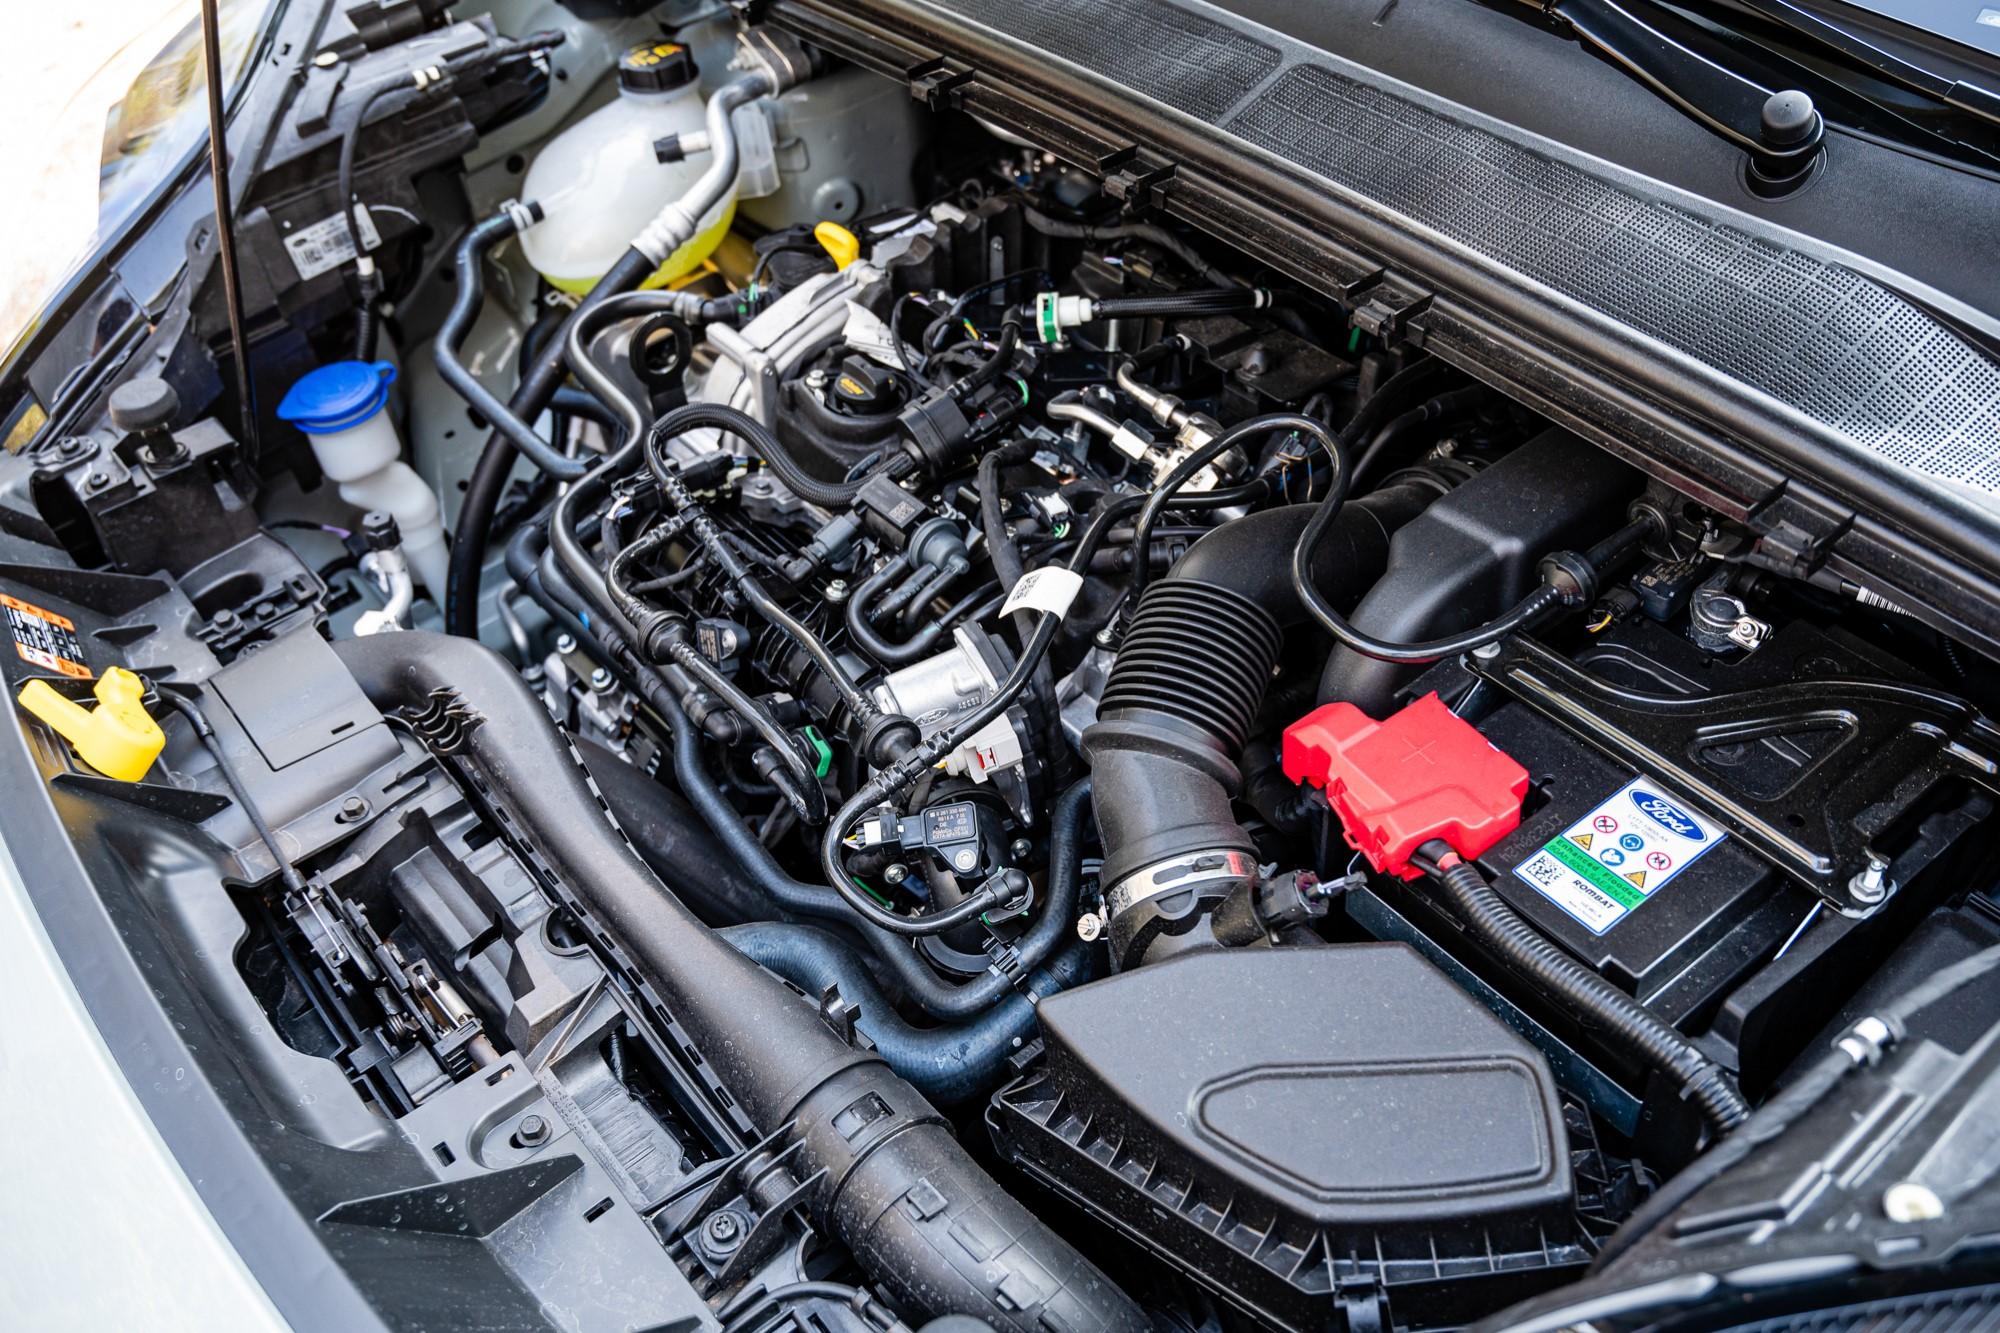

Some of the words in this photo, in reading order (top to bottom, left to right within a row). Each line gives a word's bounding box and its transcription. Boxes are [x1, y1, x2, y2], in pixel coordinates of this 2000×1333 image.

[1640, 799, 1694, 834] Ford
[1556, 839, 1600, 871] Enhanced
[1602, 873, 1640, 900] Flooded
[1572, 879, 1615, 909] ROMBAT
